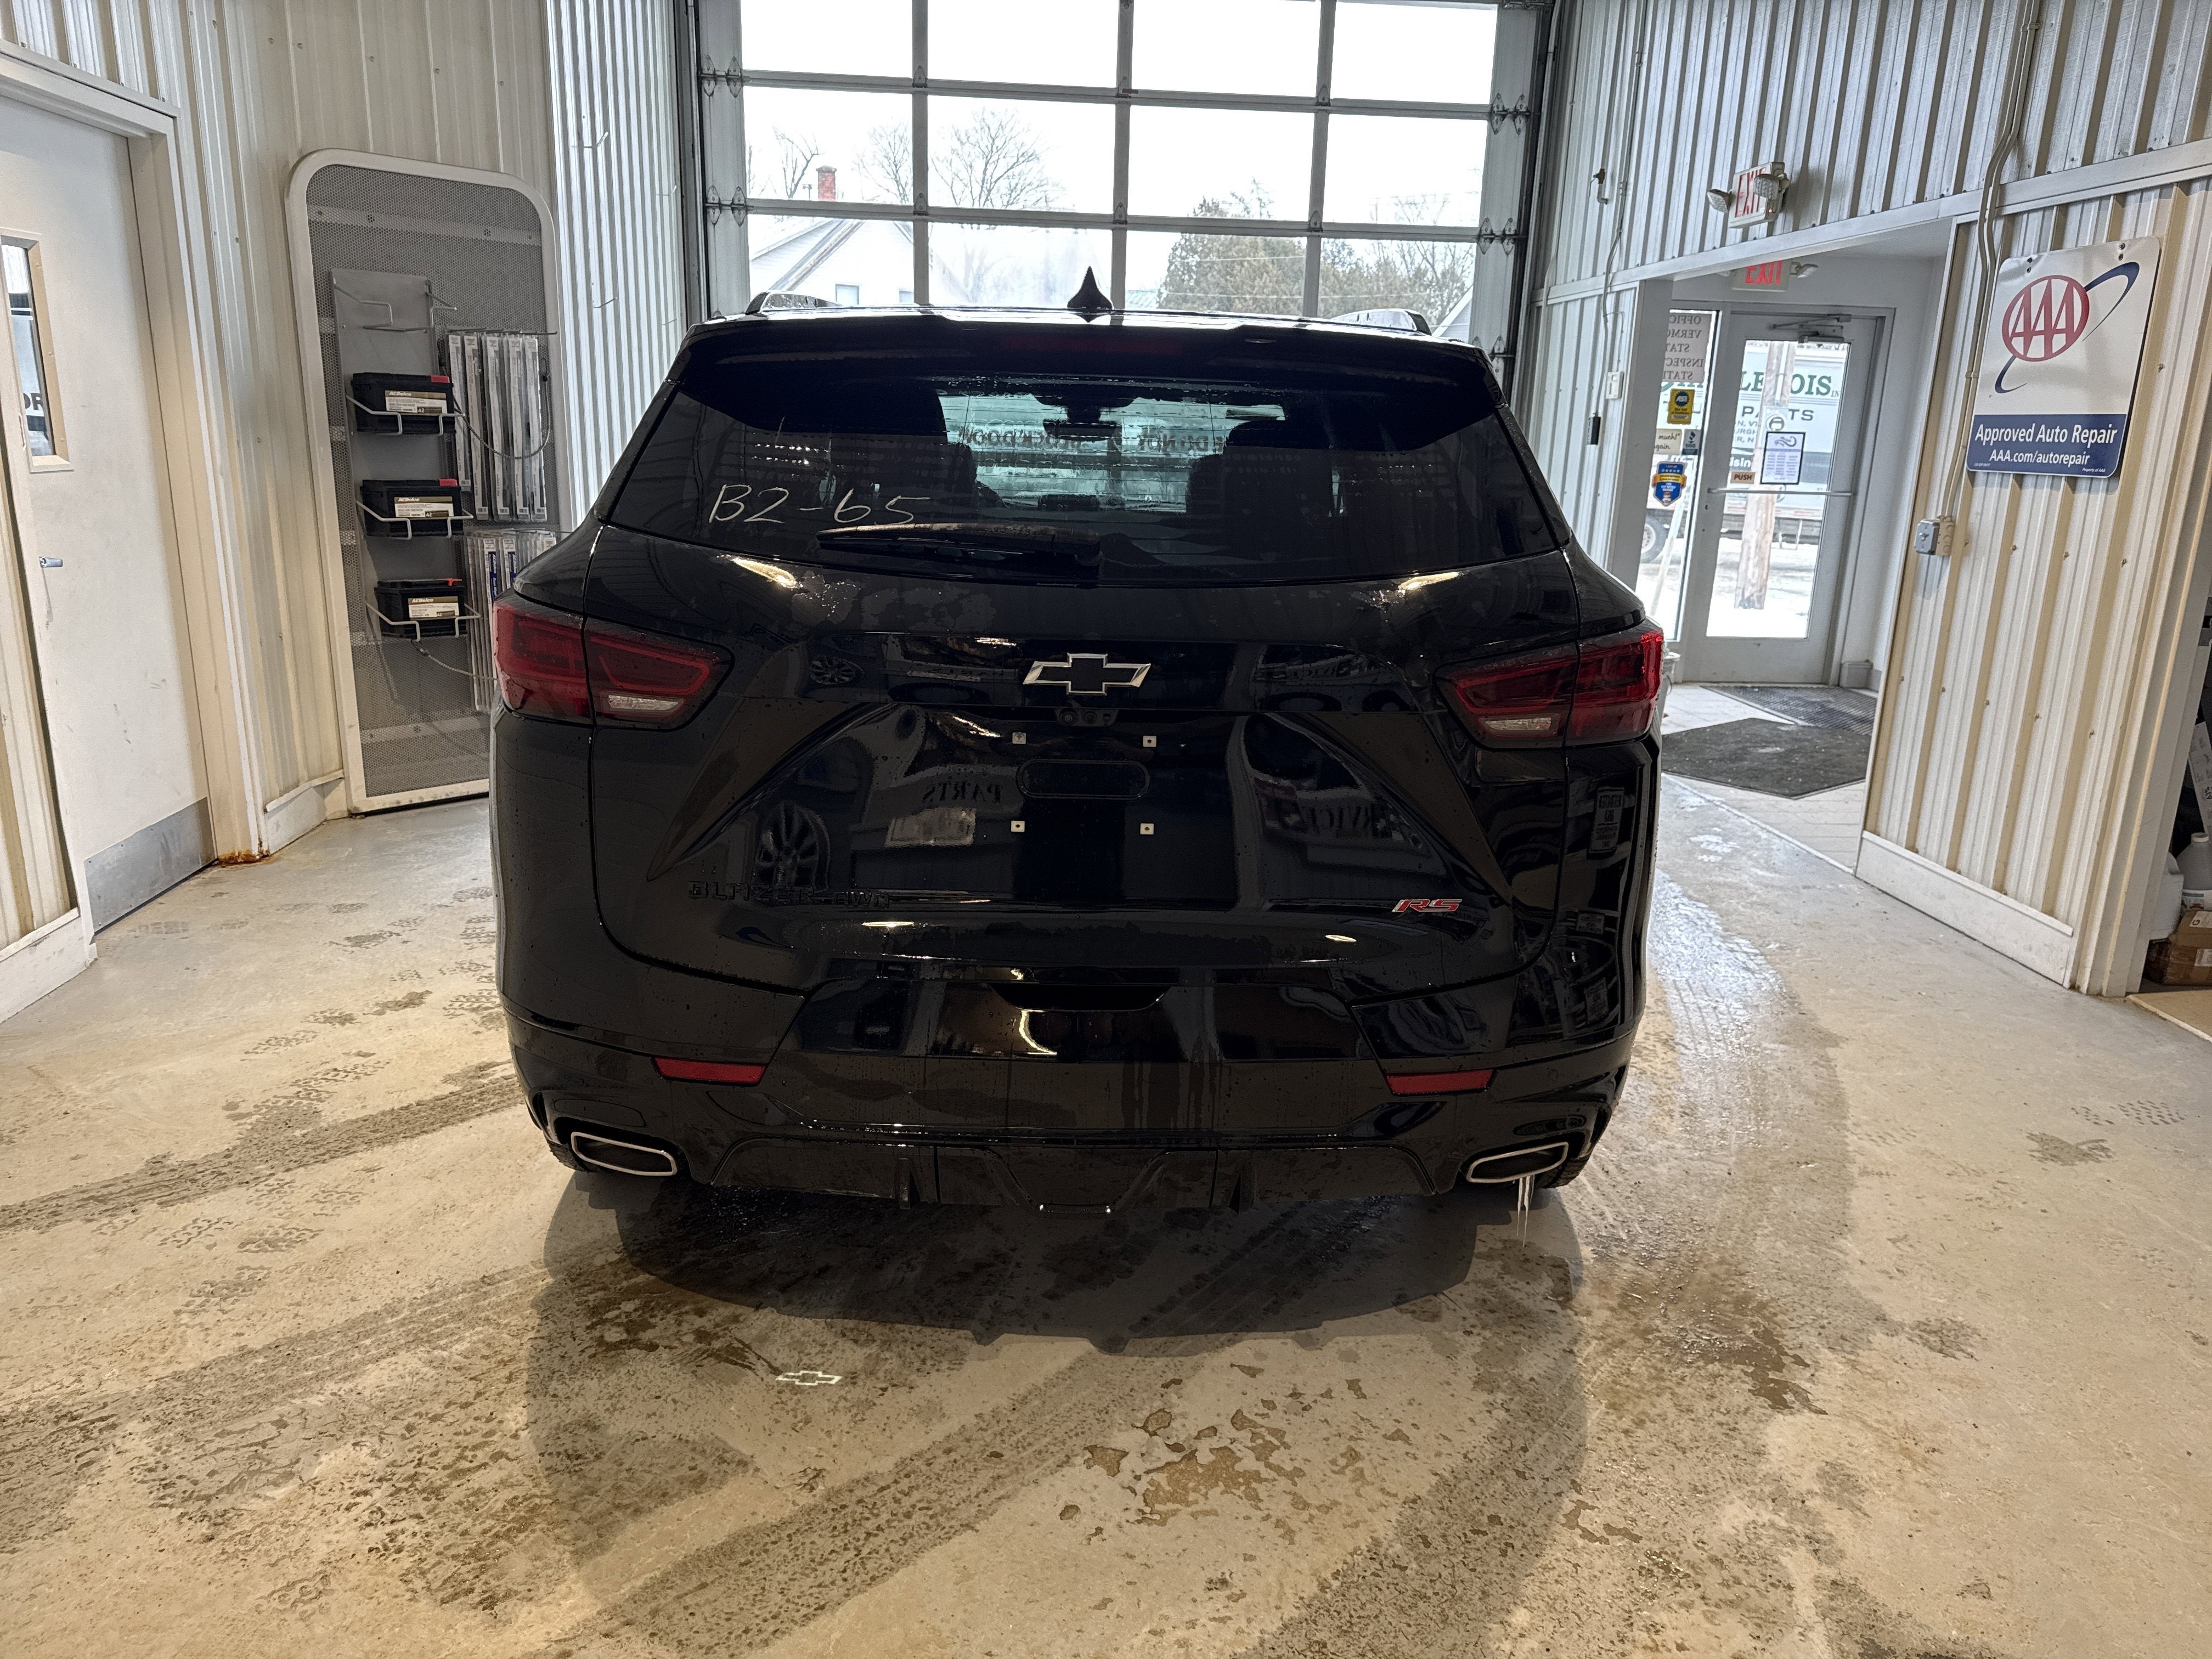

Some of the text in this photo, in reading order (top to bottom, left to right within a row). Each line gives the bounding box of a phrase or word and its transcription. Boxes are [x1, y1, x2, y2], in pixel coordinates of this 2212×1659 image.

[2004, 275, 2087, 360] AAA
[1974, 423, 2118, 448] Approved Auto Repair
[1989, 449, 2090, 467] AAA.com/autorepair
[709, 484, 930, 524] B2-65
[689, 881, 815, 904] BLAZER
[1391, 899, 1463, 912] RS
